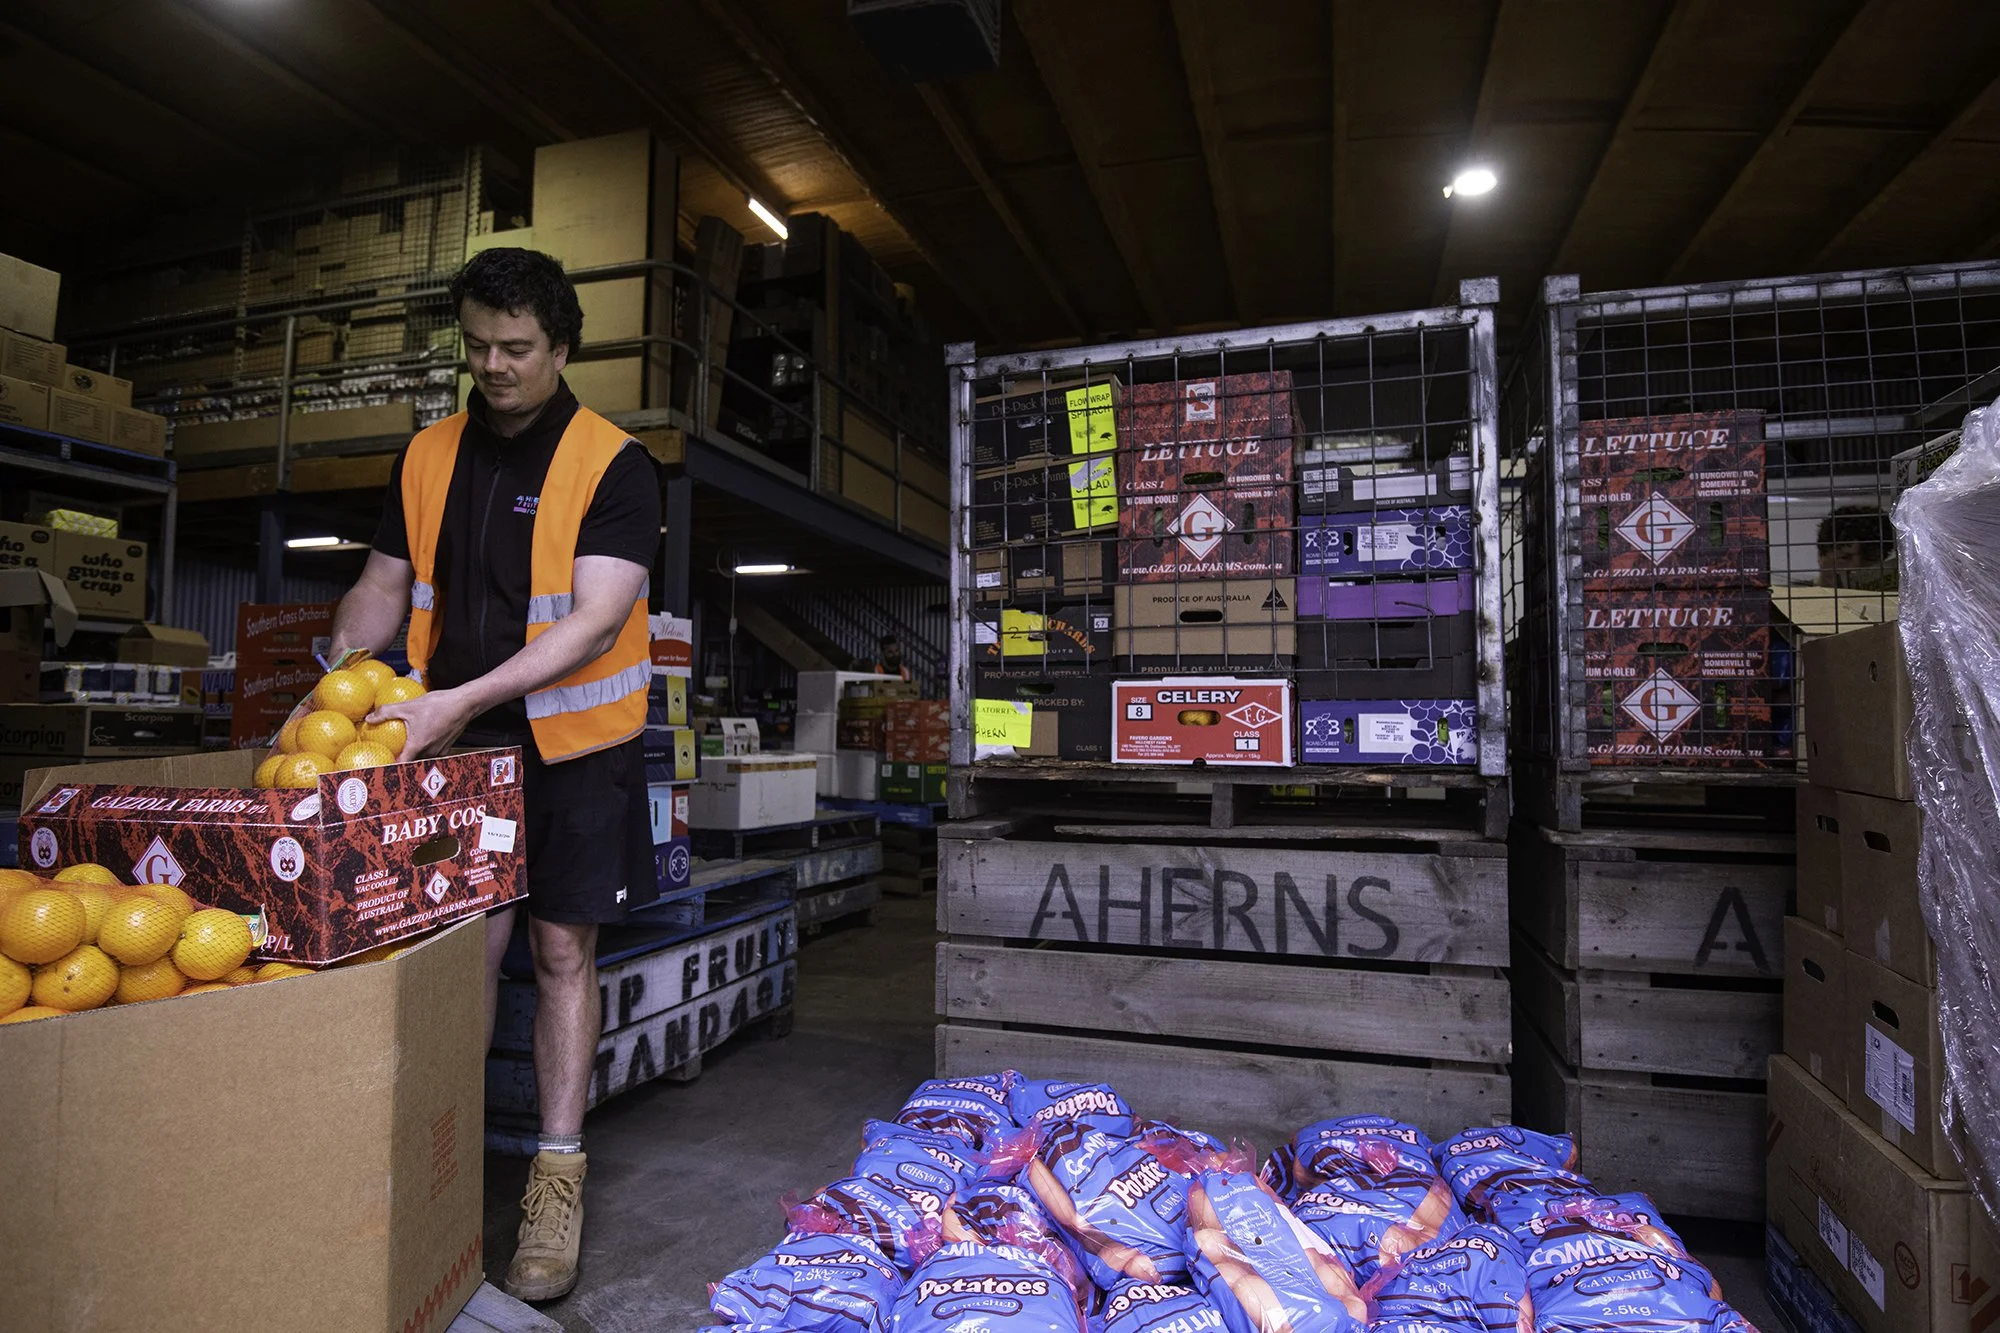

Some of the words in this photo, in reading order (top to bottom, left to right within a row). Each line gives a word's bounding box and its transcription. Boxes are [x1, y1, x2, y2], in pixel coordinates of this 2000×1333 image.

[1069, 399, 1088, 407] FLOW
[1090, 393, 1111, 403] WRAP
[1142, 435, 1261, 462] LETTUCE
[1582, 428, 1730, 457] LETTUCE
[1582, 478, 1602, 487] ASS
[1700, 480, 1747, 488] SOMERVILE
[1234, 491, 1262, 499] VICTORIA
[1698, 489, 1732, 497] VICTORIA
[1184, 510, 1217, 543] G
[1635, 510, 1677, 545] G
[0, 535, 24, 552] ho
[82, 552, 122, 568] who
[67, 566, 120, 581] gives
[123, 572, 134, 582] a
[81, 580, 122, 597] crap
[246, 612, 278, 638] Southern
[279, 609, 297, 626] Cross
[300, 607, 330, 623] Orchards
[1586, 607, 1733, 629] LETTUCE
[243, 674, 275, 698] Southern
[275, 671, 295, 688] Cross
[1157, 690, 1242, 703] CELERY
[1640, 687, 1681, 721] G
[124, 712, 174, 724] Scorpion
[1135, 707, 1143, 717] 8
[1245, 740, 1250, 749] 1
[1226, 752, 1243, 760] Weight
[428, 774, 441, 792] G
[91, 796, 177, 812] GAZZOLA
[178, 799, 251, 814] FARMS
[382, 814, 443, 845] BABY
[449, 805, 487, 831] COS
[146, 855, 172, 886] G
[355, 872, 382, 885] CLASS
[383, 870, 389, 878] 1
[355, 885, 369, 894] VAC
[369, 876, 399, 892] COOLED
[432, 879, 444, 896] G
[356, 893, 396, 911] PRODUCT
[397, 889, 409, 900] OF
[357, 901, 405, 922] AUSTRALIA
[375, 893, 494, 937] www.GAZZOLAFARMS.com.au
[1029, 863, 1401, 958] AHERNS
[265, 936, 294, 951] P/L
[682, 917, 796, 1000] FRUIT
[1036, 1091, 1120, 1121] Potatoes
[1319, 1127, 1419, 1146] Potatoes
[916, 1276, 1048, 1306] Potatoes
[1603, 1305, 1651, 1317] 2.5kg
